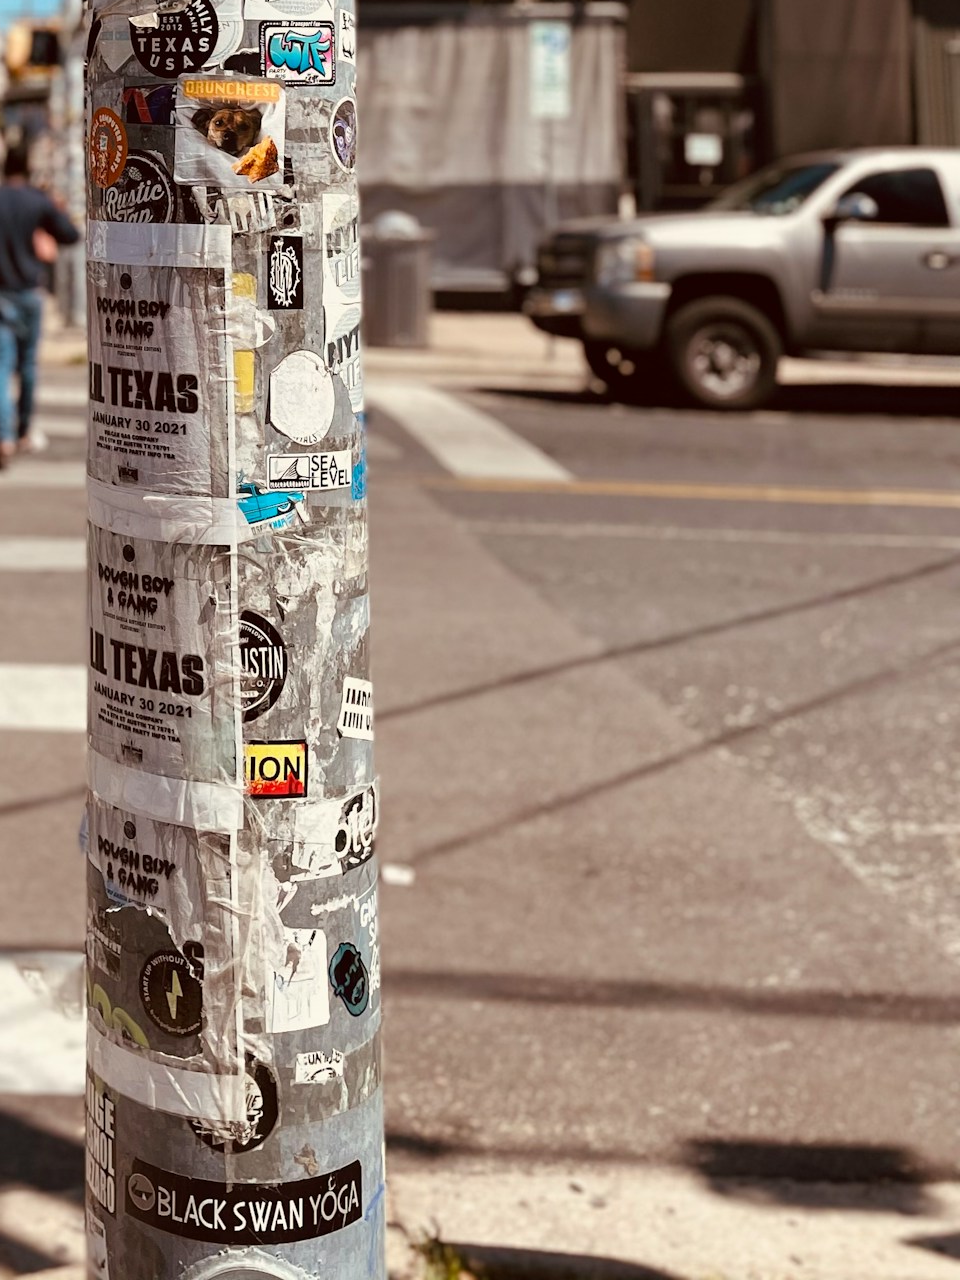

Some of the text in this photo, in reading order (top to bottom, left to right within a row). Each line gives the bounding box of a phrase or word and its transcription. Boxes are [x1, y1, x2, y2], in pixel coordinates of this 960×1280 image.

[162, 16, 181, 24] EST
[137, 37, 210, 53] TEXAS
[149, 53, 195, 71] USA
[269, 29, 331, 78] WTF
[106, 180, 165, 215] Rustic
[97, 296, 170, 320] DOUGH BOY
[115, 318, 154, 341] GANG
[107, 366, 199, 414] TEXAS
[93, 411, 187, 436] JANUARY 30 2021
[311, 455, 338, 472] SEA
[311, 469, 351, 488] LEVEL
[98, 562, 175, 598] DOUGH BOY
[107, 587, 158, 618] & GANG
[110, 638, 204, 696] TEXAS
[94, 681, 193, 718] JANUARY 30 2021
[97, 834, 139, 870] DOUGH
[106, 861, 159, 900] & GANG
[143, 954, 185, 1002] START UP WITHOUT
[157, 1178, 360, 1232] BLACK SWAN YOGA
